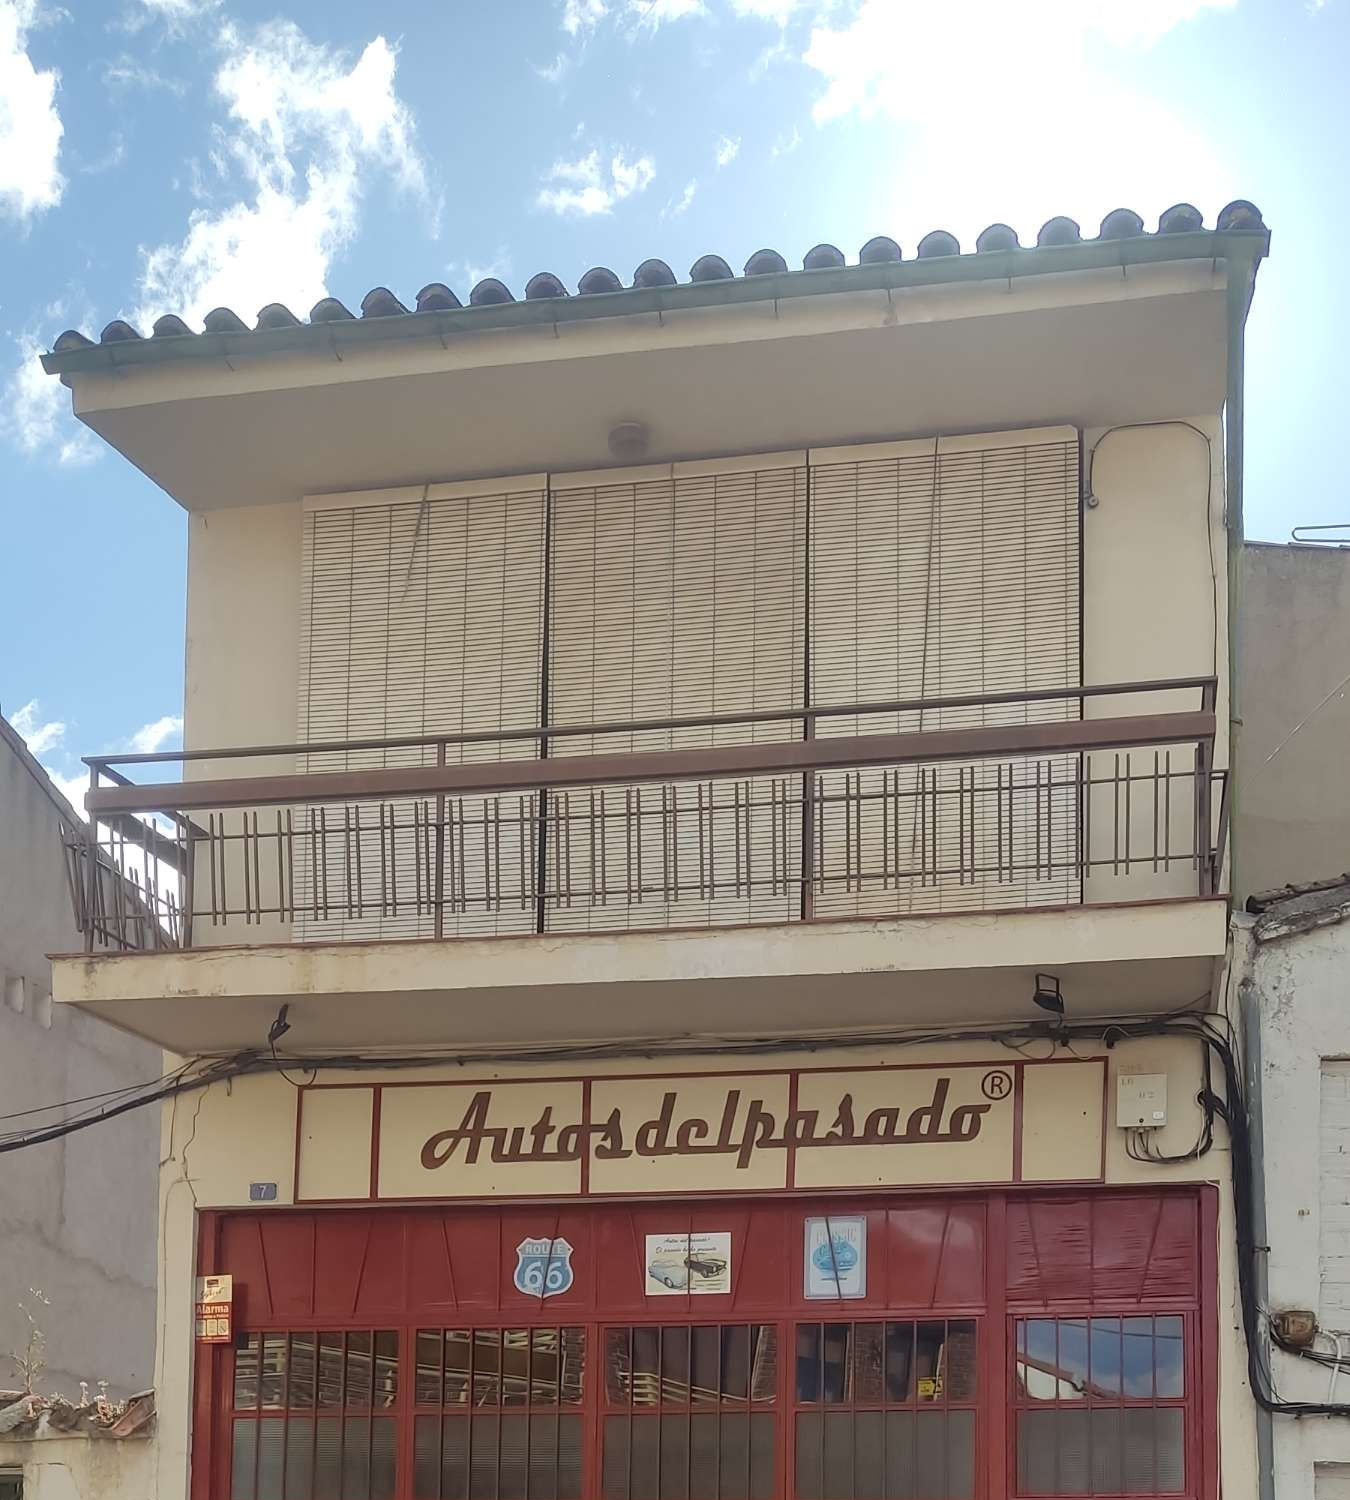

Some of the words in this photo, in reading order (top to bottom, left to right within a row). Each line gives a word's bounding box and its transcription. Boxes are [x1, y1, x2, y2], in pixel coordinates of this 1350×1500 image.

[420, 1077, 992, 1170] Autosdelpasado
[259, 1185, 267, 1199] 7
[525, 1261, 563, 1289] 66
[196, 1303, 229, 1314] Alarma
